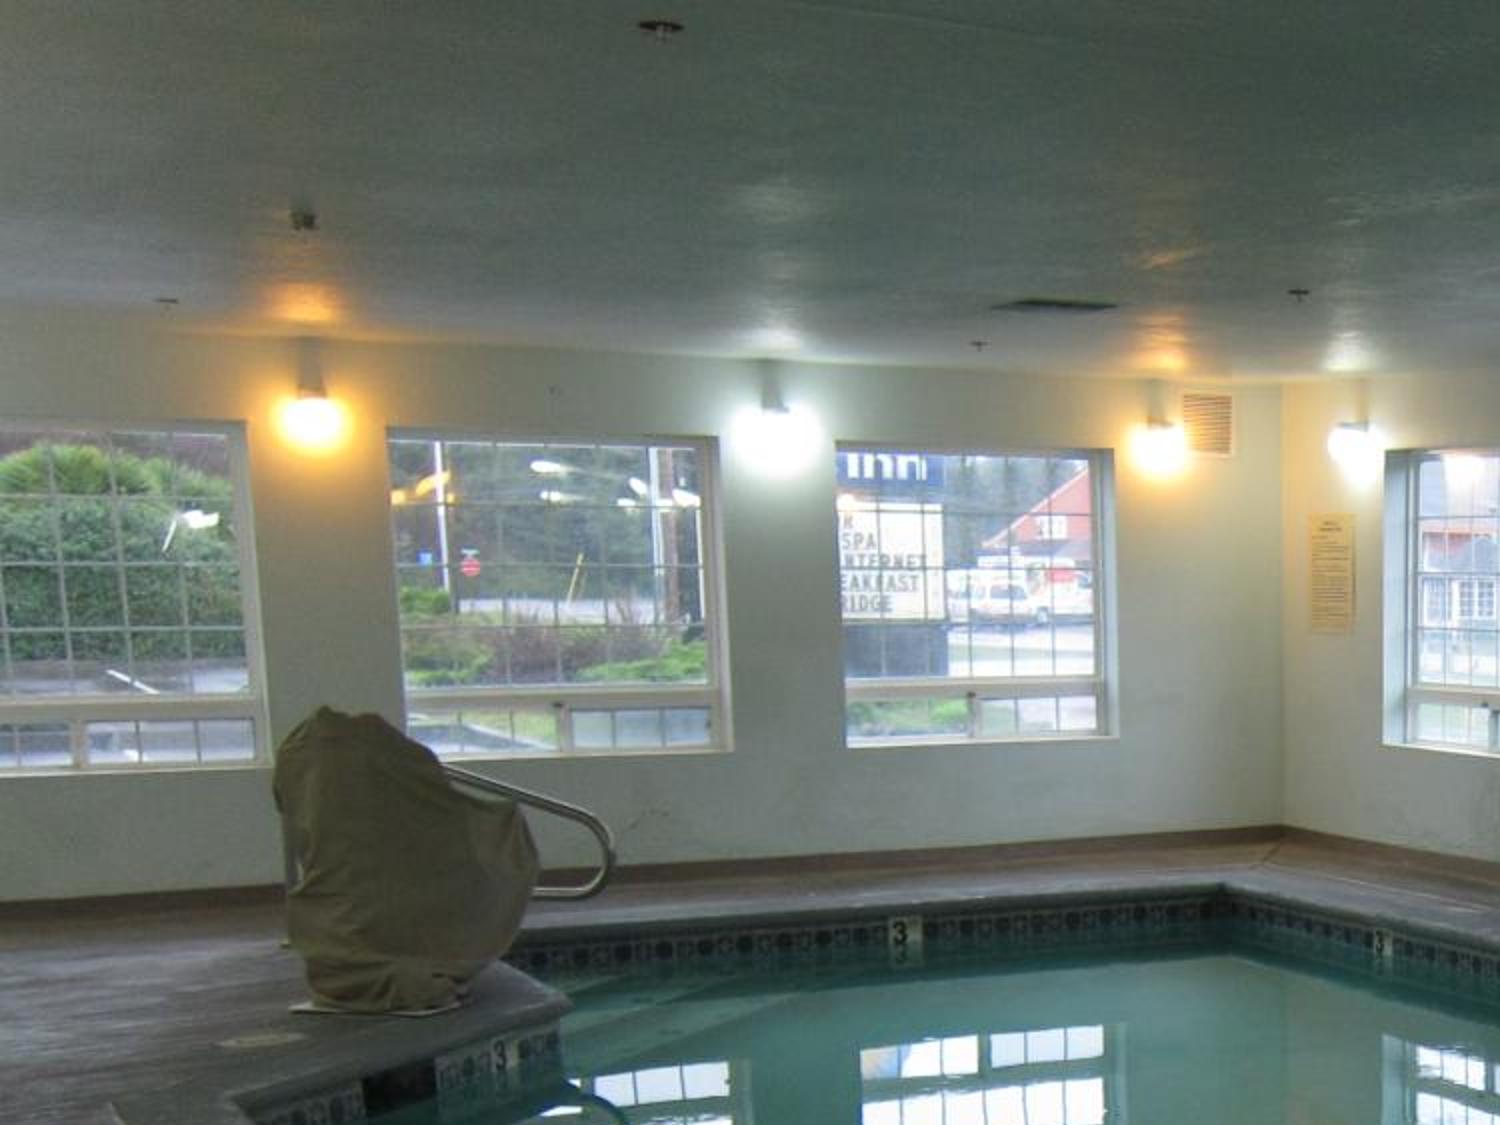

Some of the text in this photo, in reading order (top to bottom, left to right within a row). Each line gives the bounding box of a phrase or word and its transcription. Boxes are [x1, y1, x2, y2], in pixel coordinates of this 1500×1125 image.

[842, 532, 877, 550] SPA
[893, 920, 907, 945] 3
[494, 1040, 506, 1071] 3
